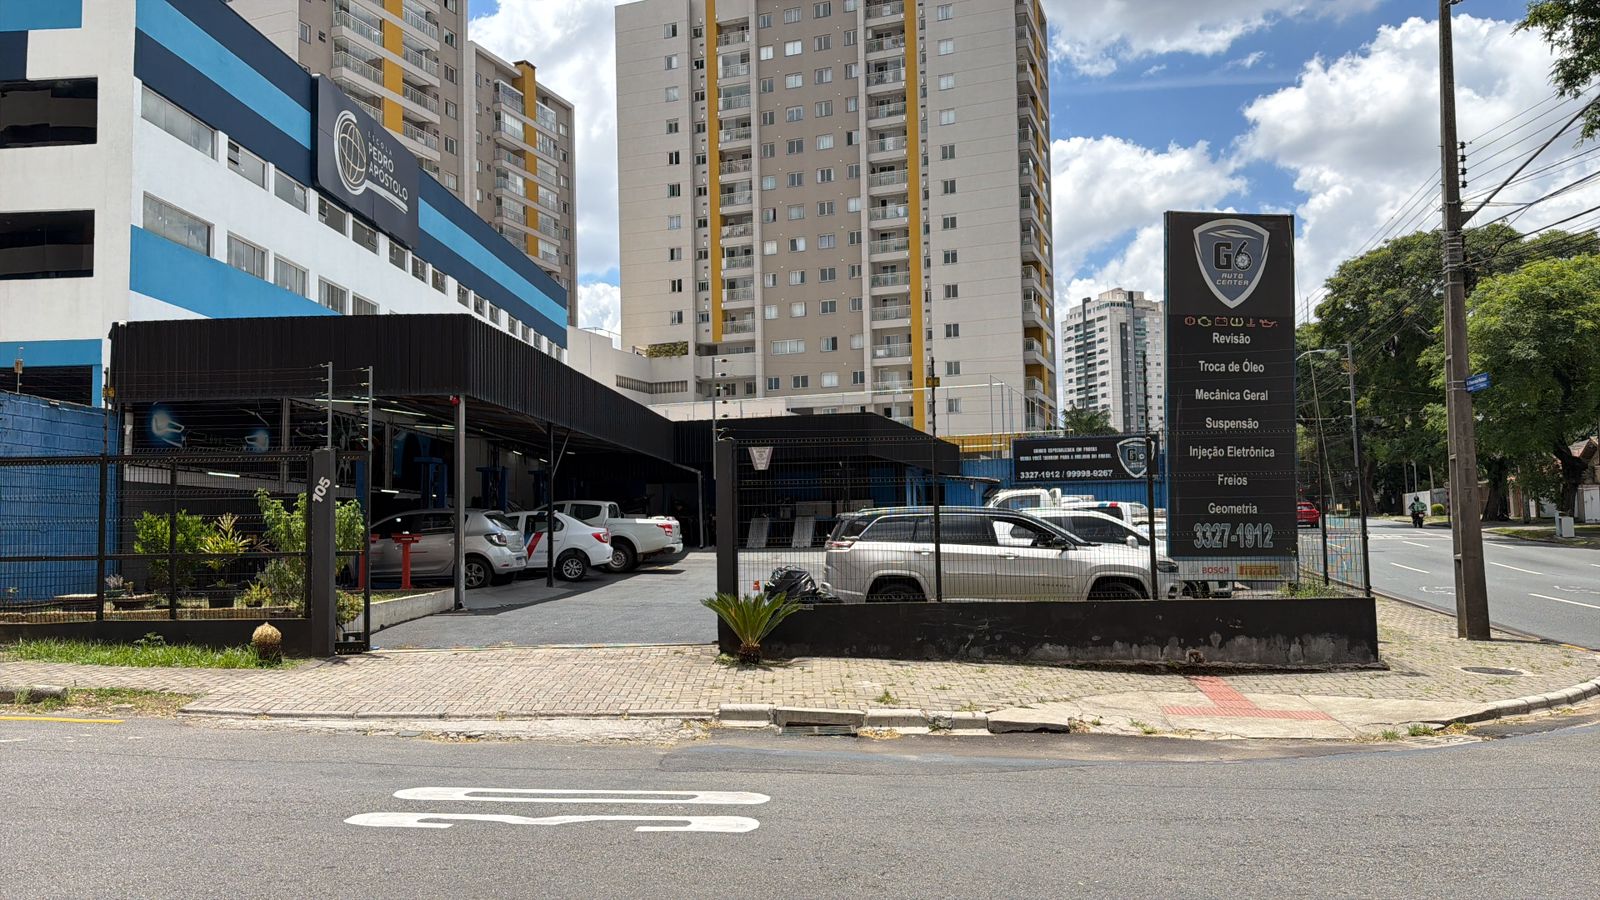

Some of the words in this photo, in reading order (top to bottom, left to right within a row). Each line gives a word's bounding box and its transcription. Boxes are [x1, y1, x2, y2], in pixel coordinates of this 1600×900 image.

[368, 142, 394, 173] PEDRO
[368, 161, 409, 201] APÓSTOLO
[1213, 240, 1252, 271] G6
[1212, 332, 1251, 344] Revisão
[1198, 360, 1226, 372] Troca
[1228, 361, 1240, 372] de
[1242, 358, 1265, 373] Óleo
[1195, 388, 1241, 400] Mecânica
[1243, 389, 1269, 401] Geral
[1205, 417, 1259, 430] Suspensão
[1189, 445, 1225, 460] Injeção
[1227, 446, 1275, 458] Eletrônica
[1020, 470, 1060, 479] 3327-1912
[1217, 474, 1248, 486] Freios
[312, 476, 331, 503] 105
[1207, 502, 1258, 514] Geometria
[1193, 522, 1274, 549] 3327-1912
[1202, 566, 1230, 574] BOSCH
